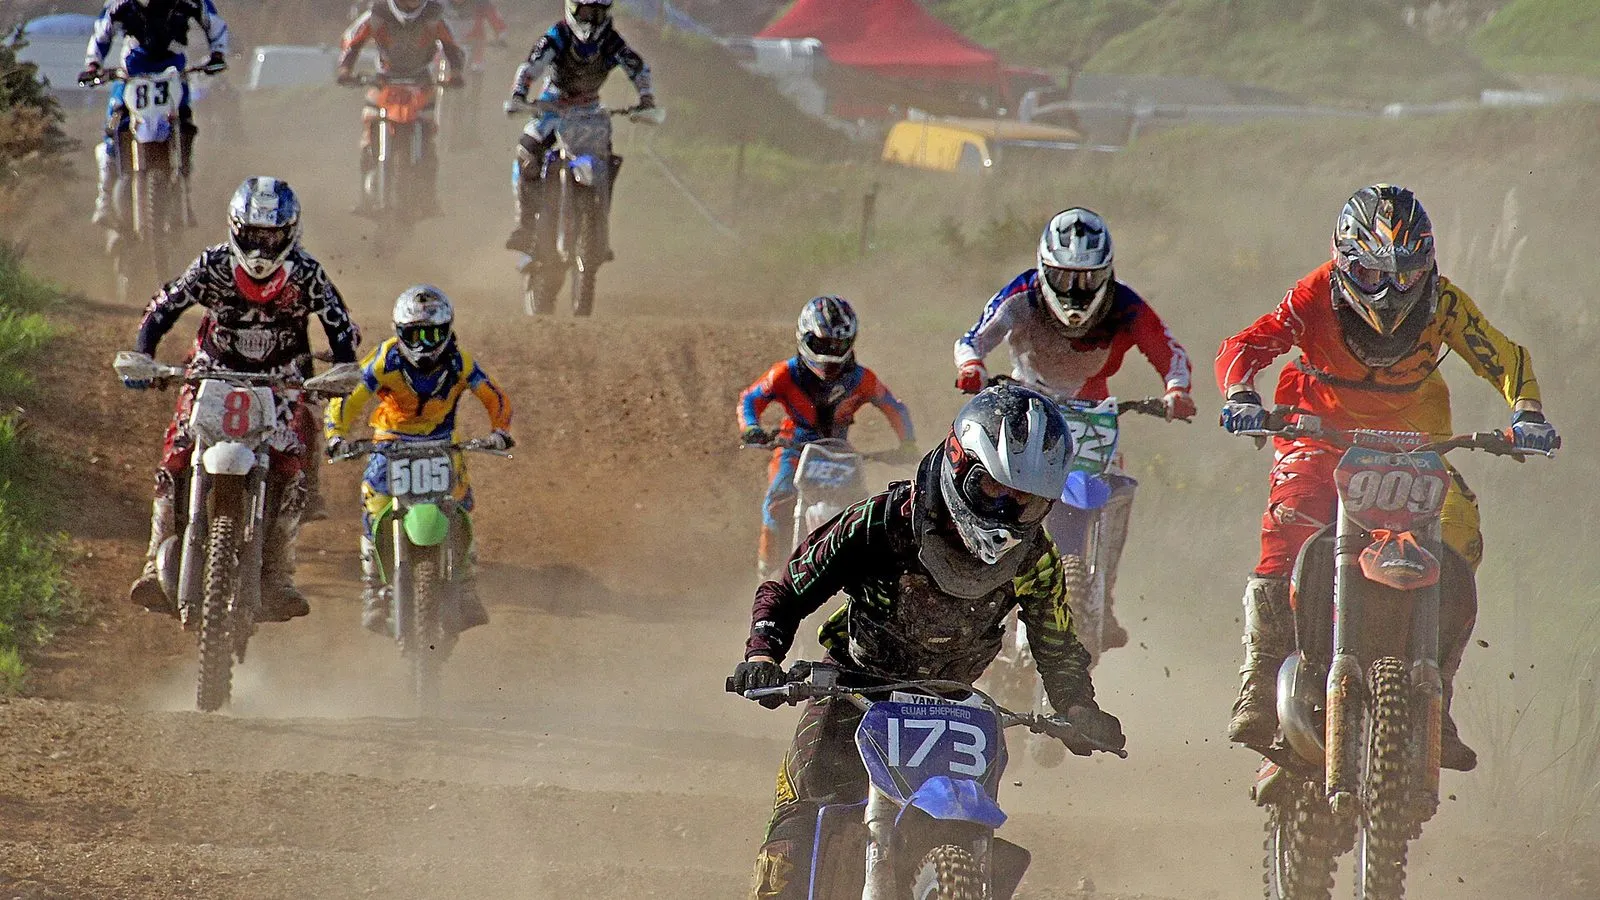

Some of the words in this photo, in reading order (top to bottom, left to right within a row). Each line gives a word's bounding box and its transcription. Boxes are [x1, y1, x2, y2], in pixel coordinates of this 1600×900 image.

[136, 81, 169, 109] 83
[222, 391, 251, 437] 8
[390, 456, 450, 496] 505
[1344, 470, 1444, 513] 909
[929, 707, 971, 720] SHEPHERD
[886, 717, 988, 777] 173
